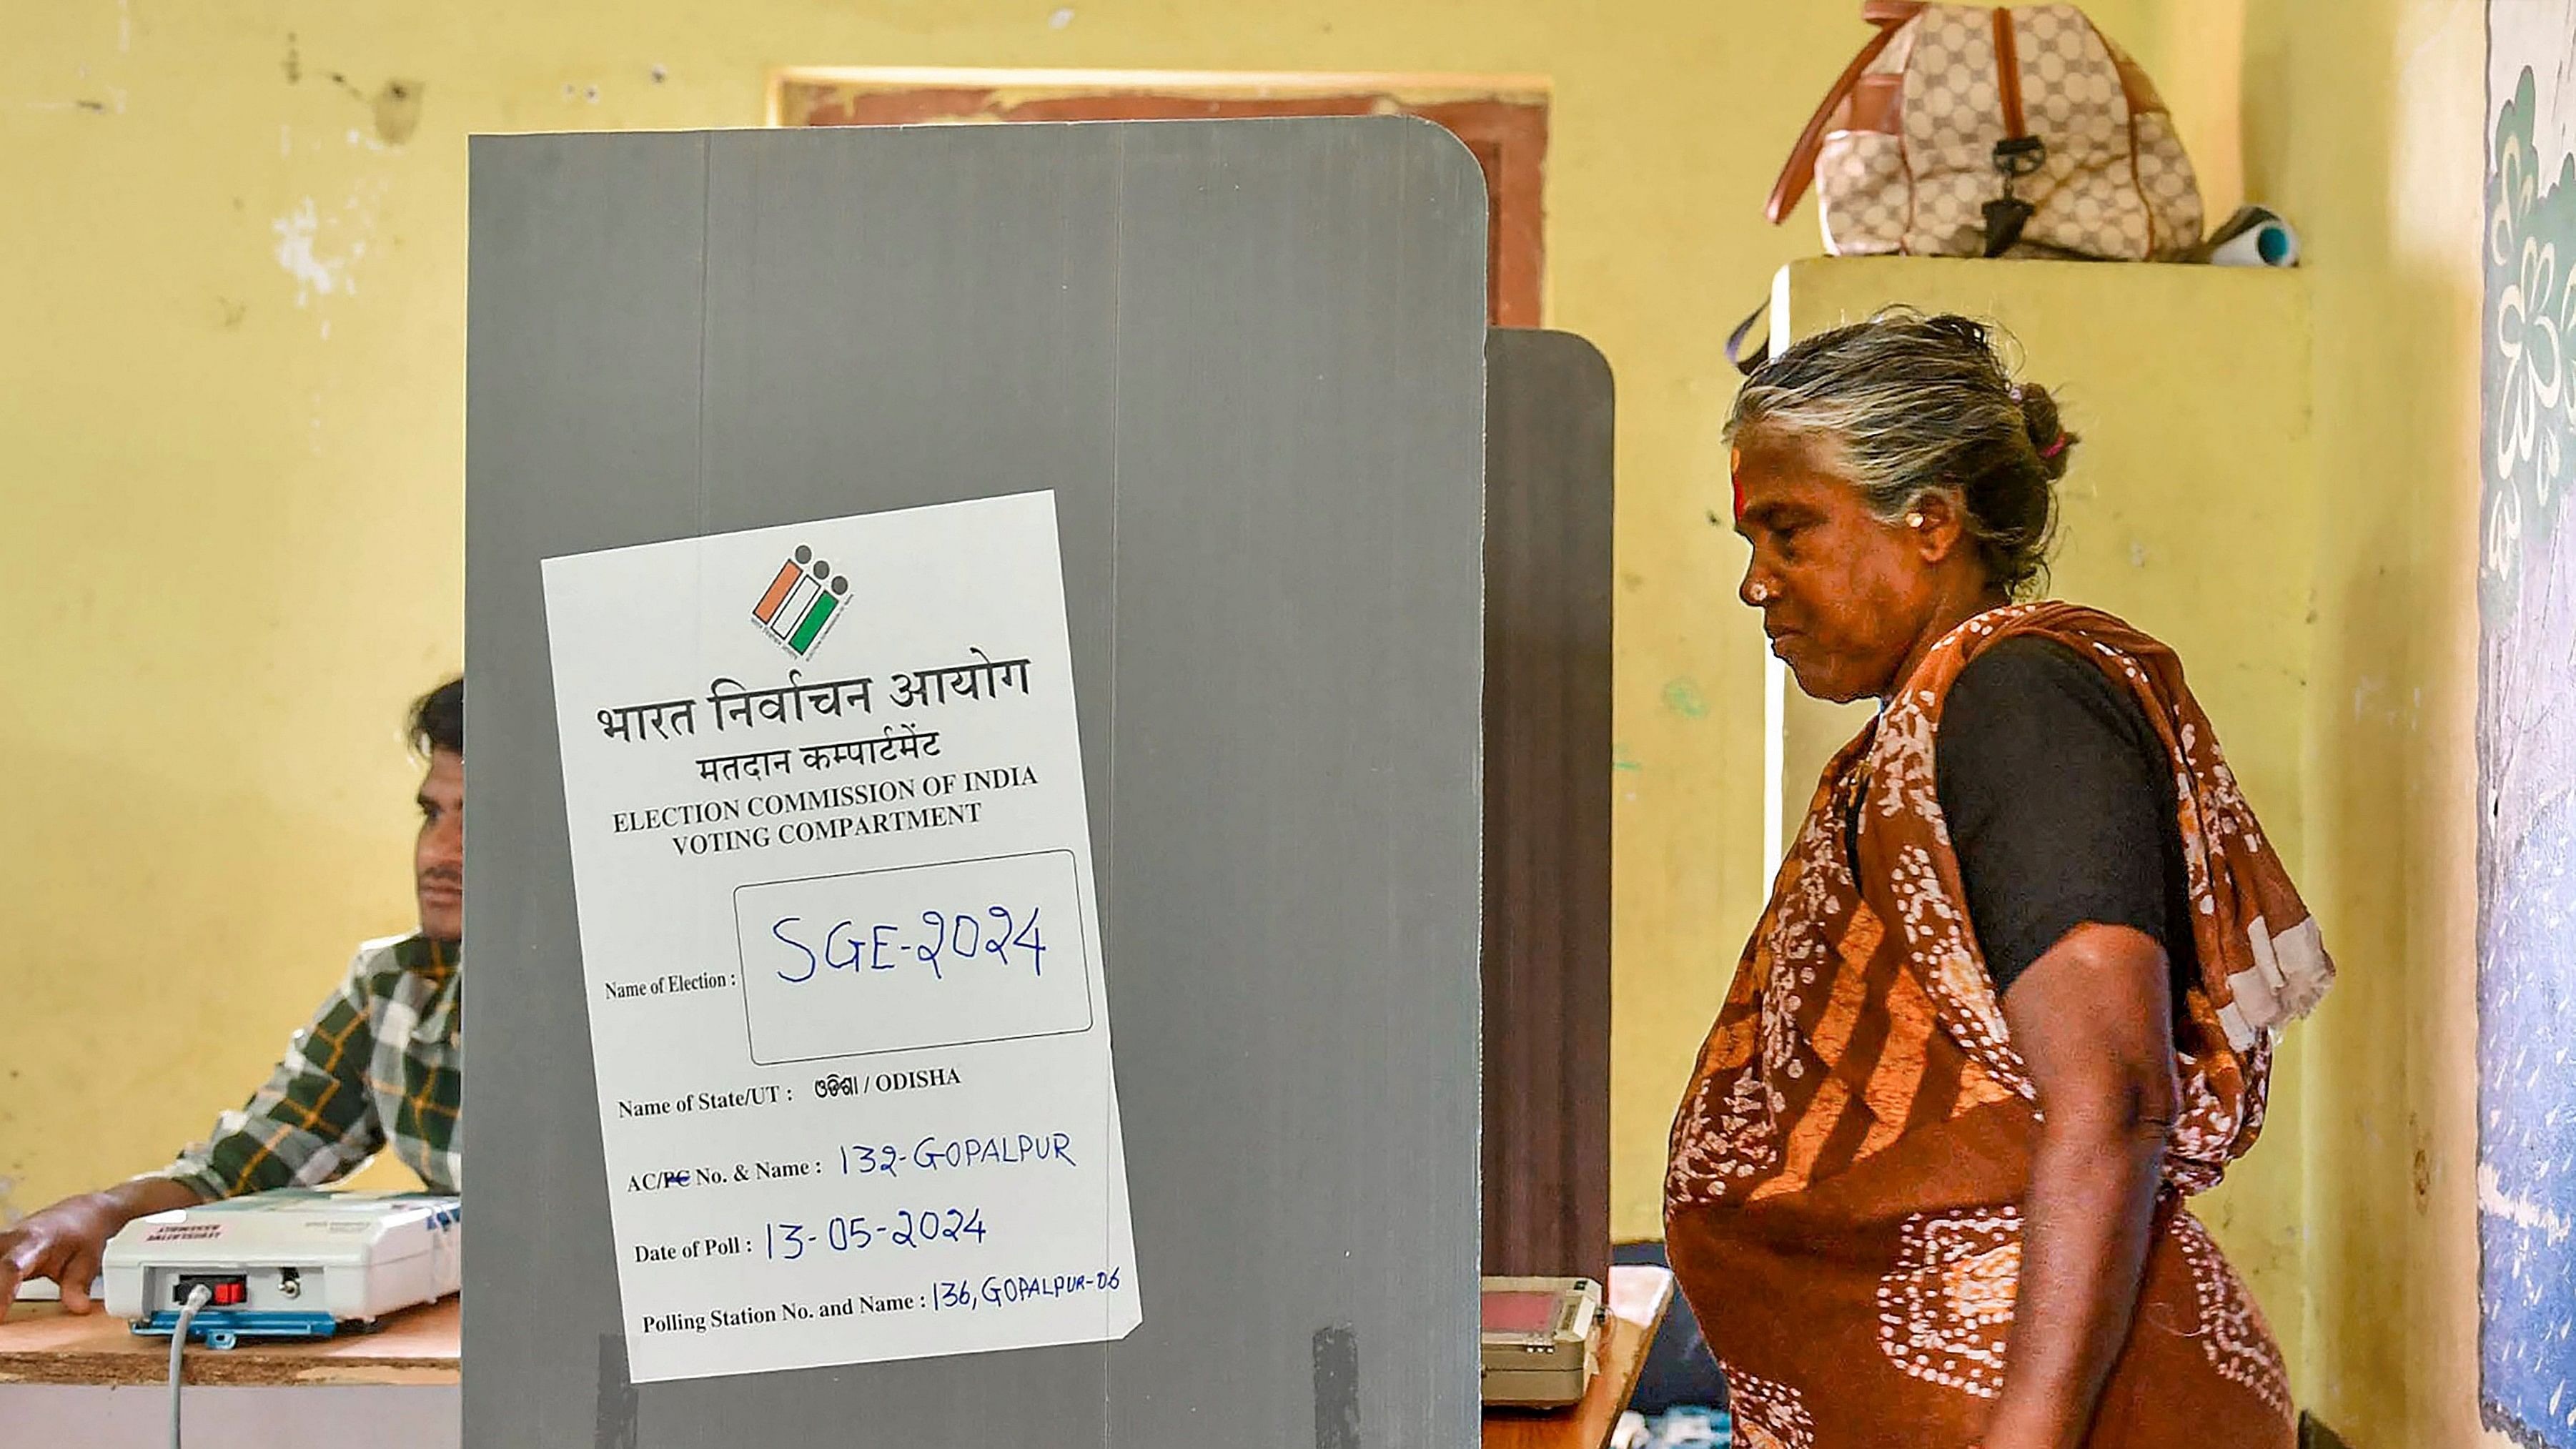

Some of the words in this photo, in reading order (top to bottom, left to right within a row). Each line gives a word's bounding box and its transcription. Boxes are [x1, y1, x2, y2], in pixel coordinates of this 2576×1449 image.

[598, 700, 696, 742] भारत
[706, 669, 873, 731] निर्वाचन
[890, 648, 1031, 707] आयोग
[695, 750, 791, 782] मतदान
[799, 723, 940, 770] कम्पार्टमेंट
[614, 800, 738, 834] ELECTION
[748, 778, 914, 816] COMMISSION
[923, 774, 956, 796] OF
[964, 766, 1038, 791] INDIA
[673, 826, 769, 855] VOTING
[779, 802, 981, 844] COMPARTMENT
[605, 982, 646, 999] Name
[650, 977, 664, 994] of
[668, 972, 725, 992] Election
[773, 906, 1046, 982] SGE-2024
[619, 1101, 670, 1118] Name
[677, 1094, 693, 1112] of
[699, 1086, 779, 1109] State/UT
[876, 1068, 961, 1092] ODISHA
[696, 1168, 727, 1185] No.
[734, 1164, 749, 1182] &
[756, 1162, 808, 1180] Name
[635, 1246, 675, 1262] Date
[683, 1241, 700, 1257] of
[705, 1237, 739, 1255] Poll
[644, 1314, 706, 1332] Polling
[711, 1307, 776, 1327] Station
[782, 1303, 813, 1320] No.
[820, 1298, 853, 1317] and
[860, 1296, 913, 1313] Name
